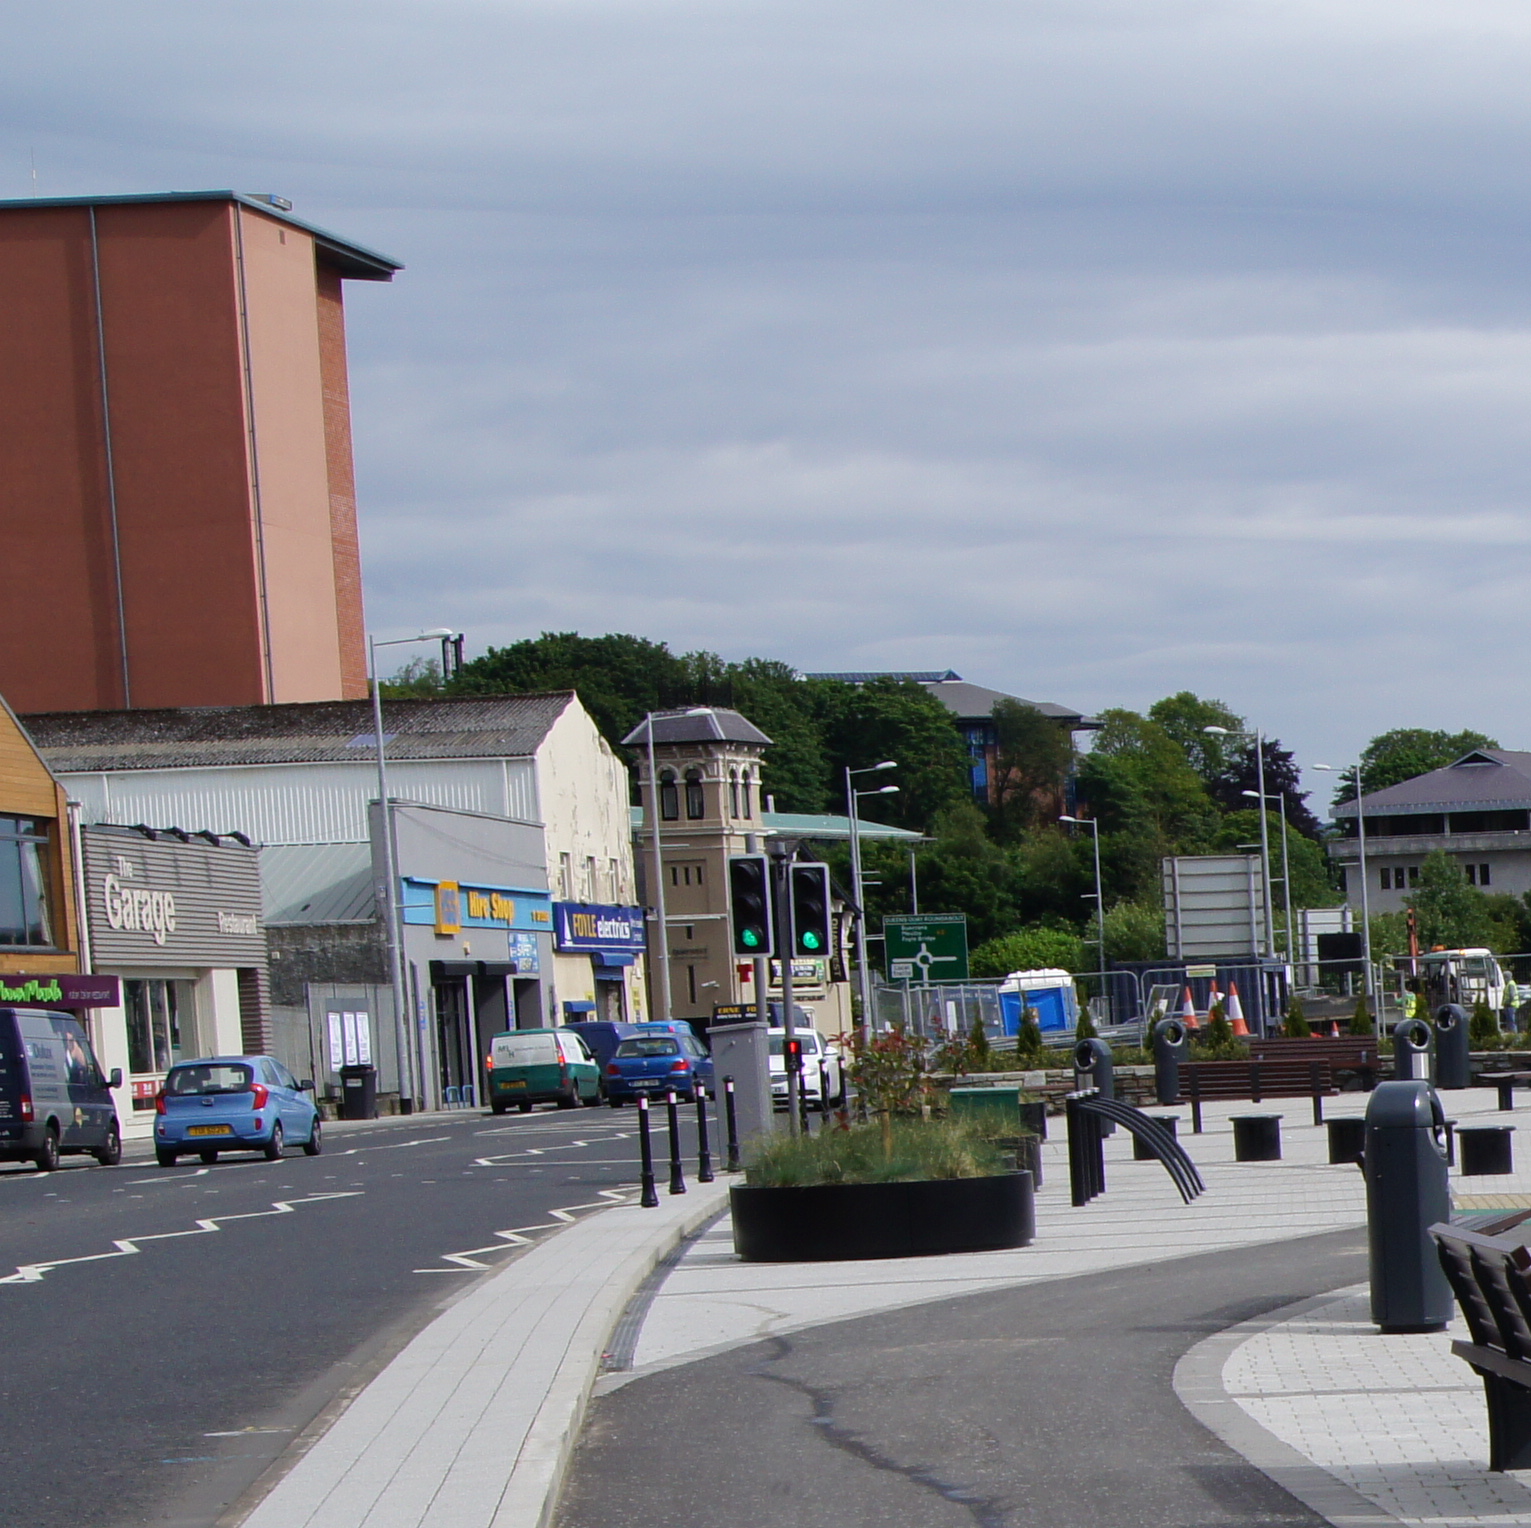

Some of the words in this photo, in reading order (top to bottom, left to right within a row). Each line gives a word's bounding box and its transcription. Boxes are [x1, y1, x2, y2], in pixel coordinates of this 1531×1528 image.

[117, 855, 133, 878] The
[105, 873, 176, 945] Garage
[468, 891, 489, 917] Hire
[490, 893, 515, 926] Shop
[218, 911, 258, 934] Restaurant
[572, 913, 597, 938] FOYLE
[597, 914, 631, 939] electrics
